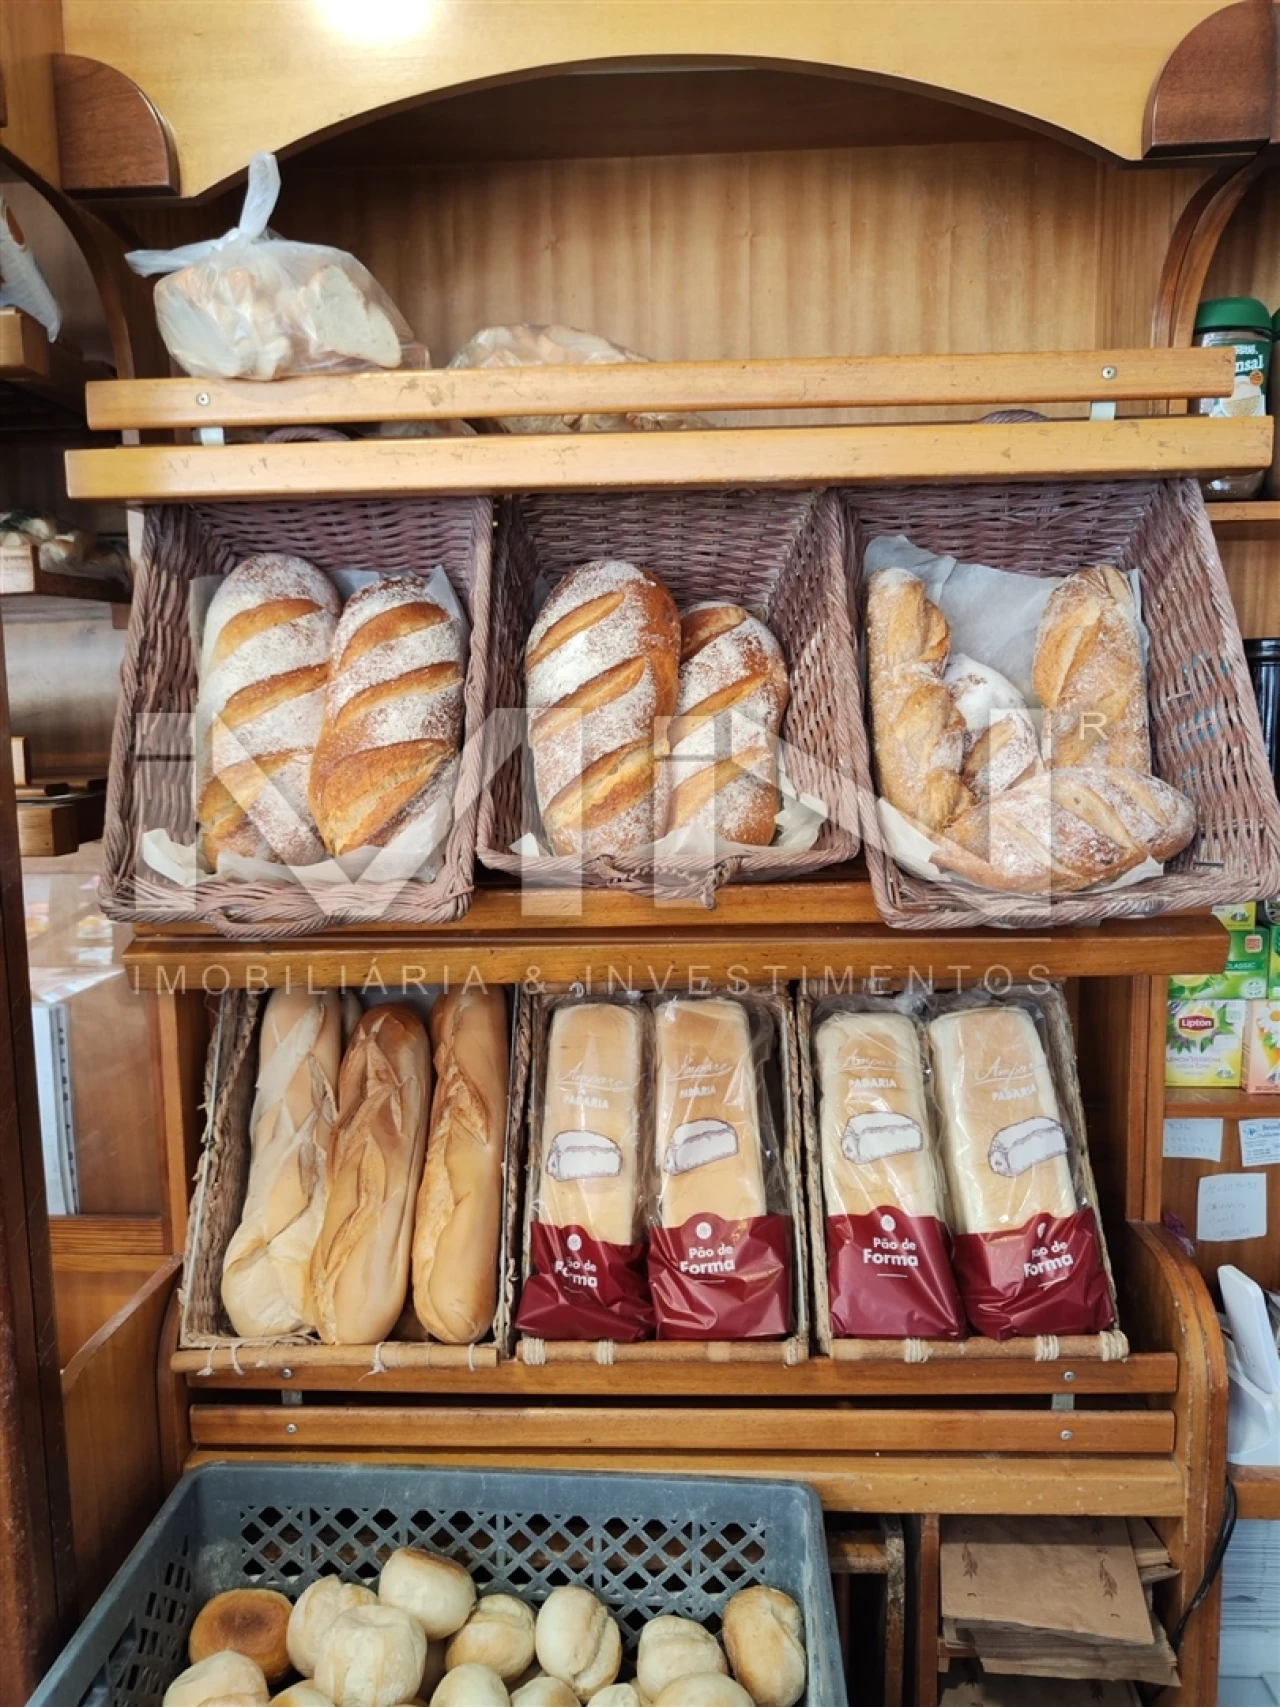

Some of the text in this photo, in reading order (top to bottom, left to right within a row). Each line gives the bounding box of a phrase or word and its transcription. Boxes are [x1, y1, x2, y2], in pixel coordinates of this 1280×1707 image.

[1181, 1018, 1212, 1028] Lipton
[688, 1242, 733, 1259] Pão de
[873, 1236, 917, 1251] Pão de
[1051, 1240, 1069, 1253] de
[863, 1248, 919, 1267] Forma
[1023, 1252, 1074, 1278] Forma
[584, 1259, 597, 1273] de
[679, 1258, 736, 1275] Forma
